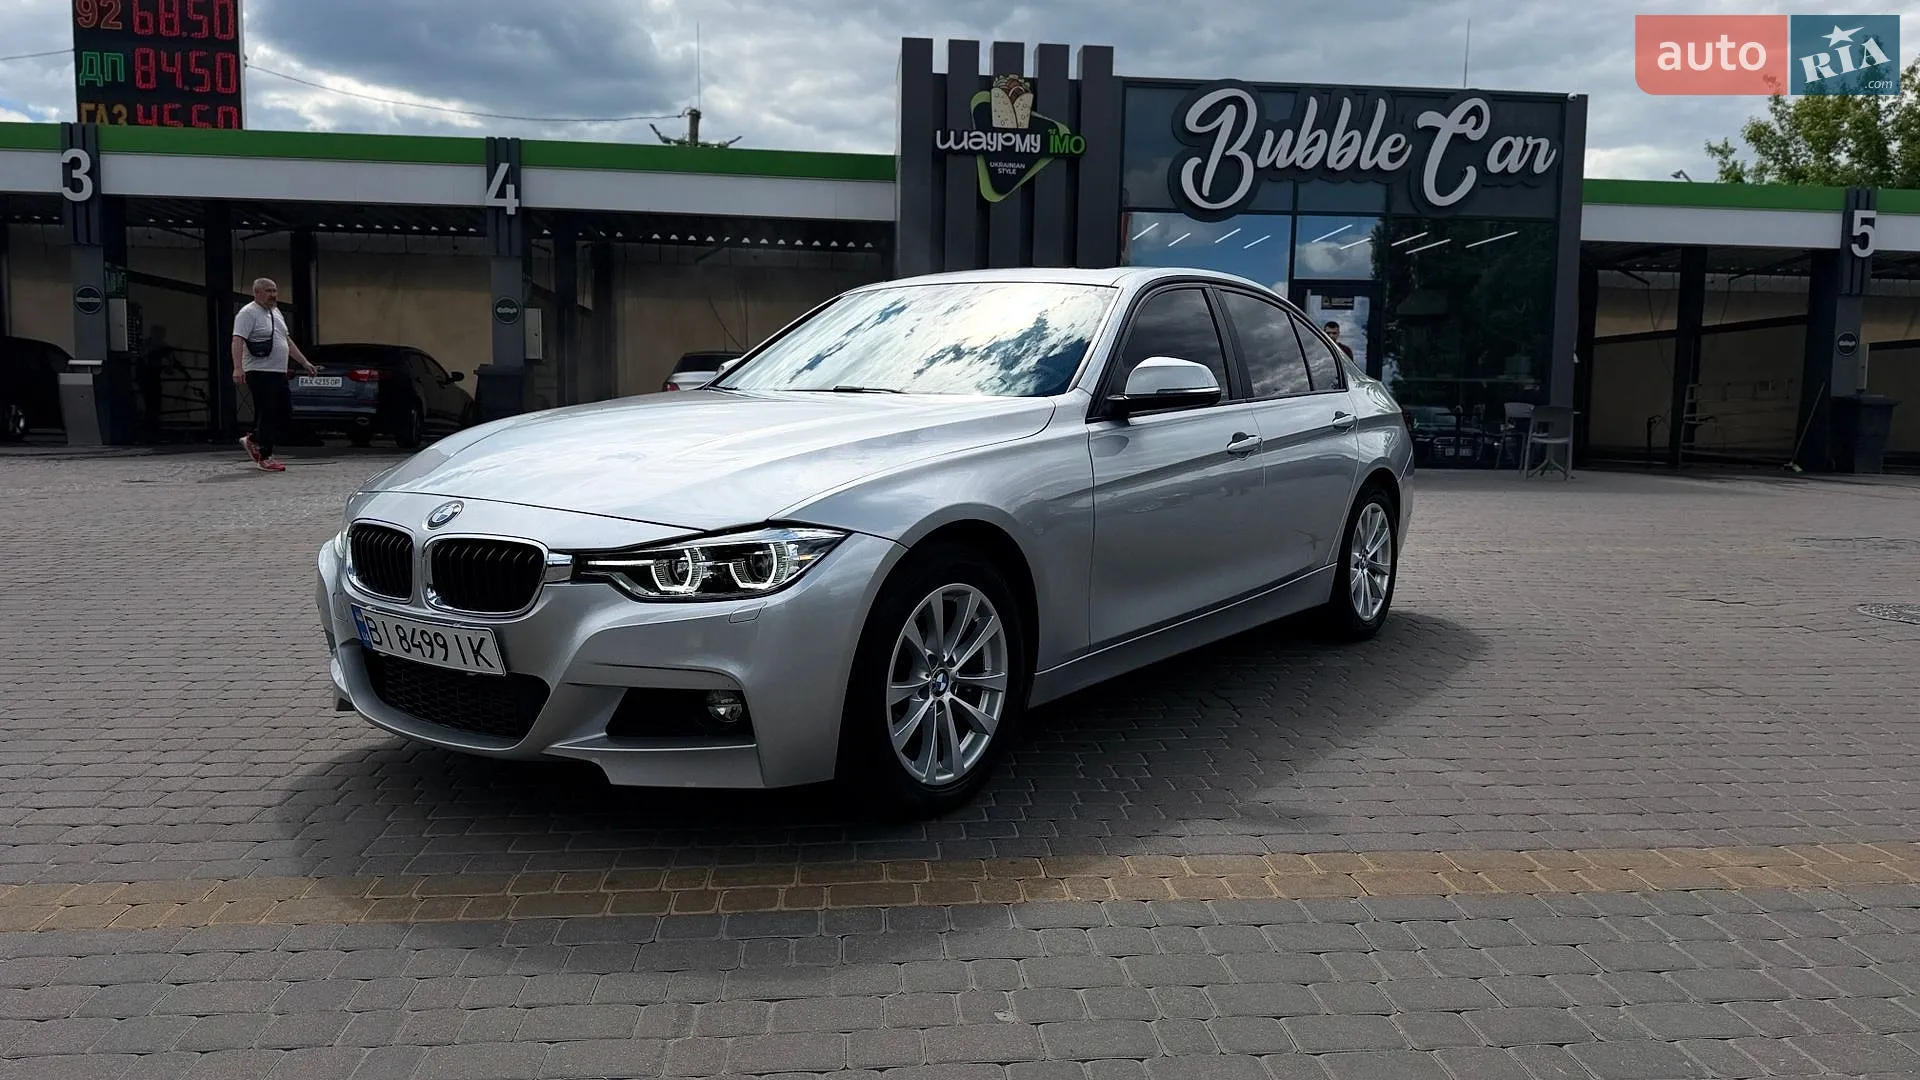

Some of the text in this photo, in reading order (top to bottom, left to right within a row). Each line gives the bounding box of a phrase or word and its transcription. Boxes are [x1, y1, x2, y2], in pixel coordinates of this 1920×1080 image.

[76, 0, 235, 40] 92 68.50
[79, 47, 237, 94] ДП 84.50
[79, 102, 239, 129] ГАЗ 4550
[989, 161, 1026, 169] UKRAINIAN
[1181, 88, 1557, 210] Bubble Car
[61, 148, 92, 202] 3
[484, 162, 519, 215] 4
[1851, 209, 1877, 258] 5
[364, 615, 496, 668] BI 8499 IK
